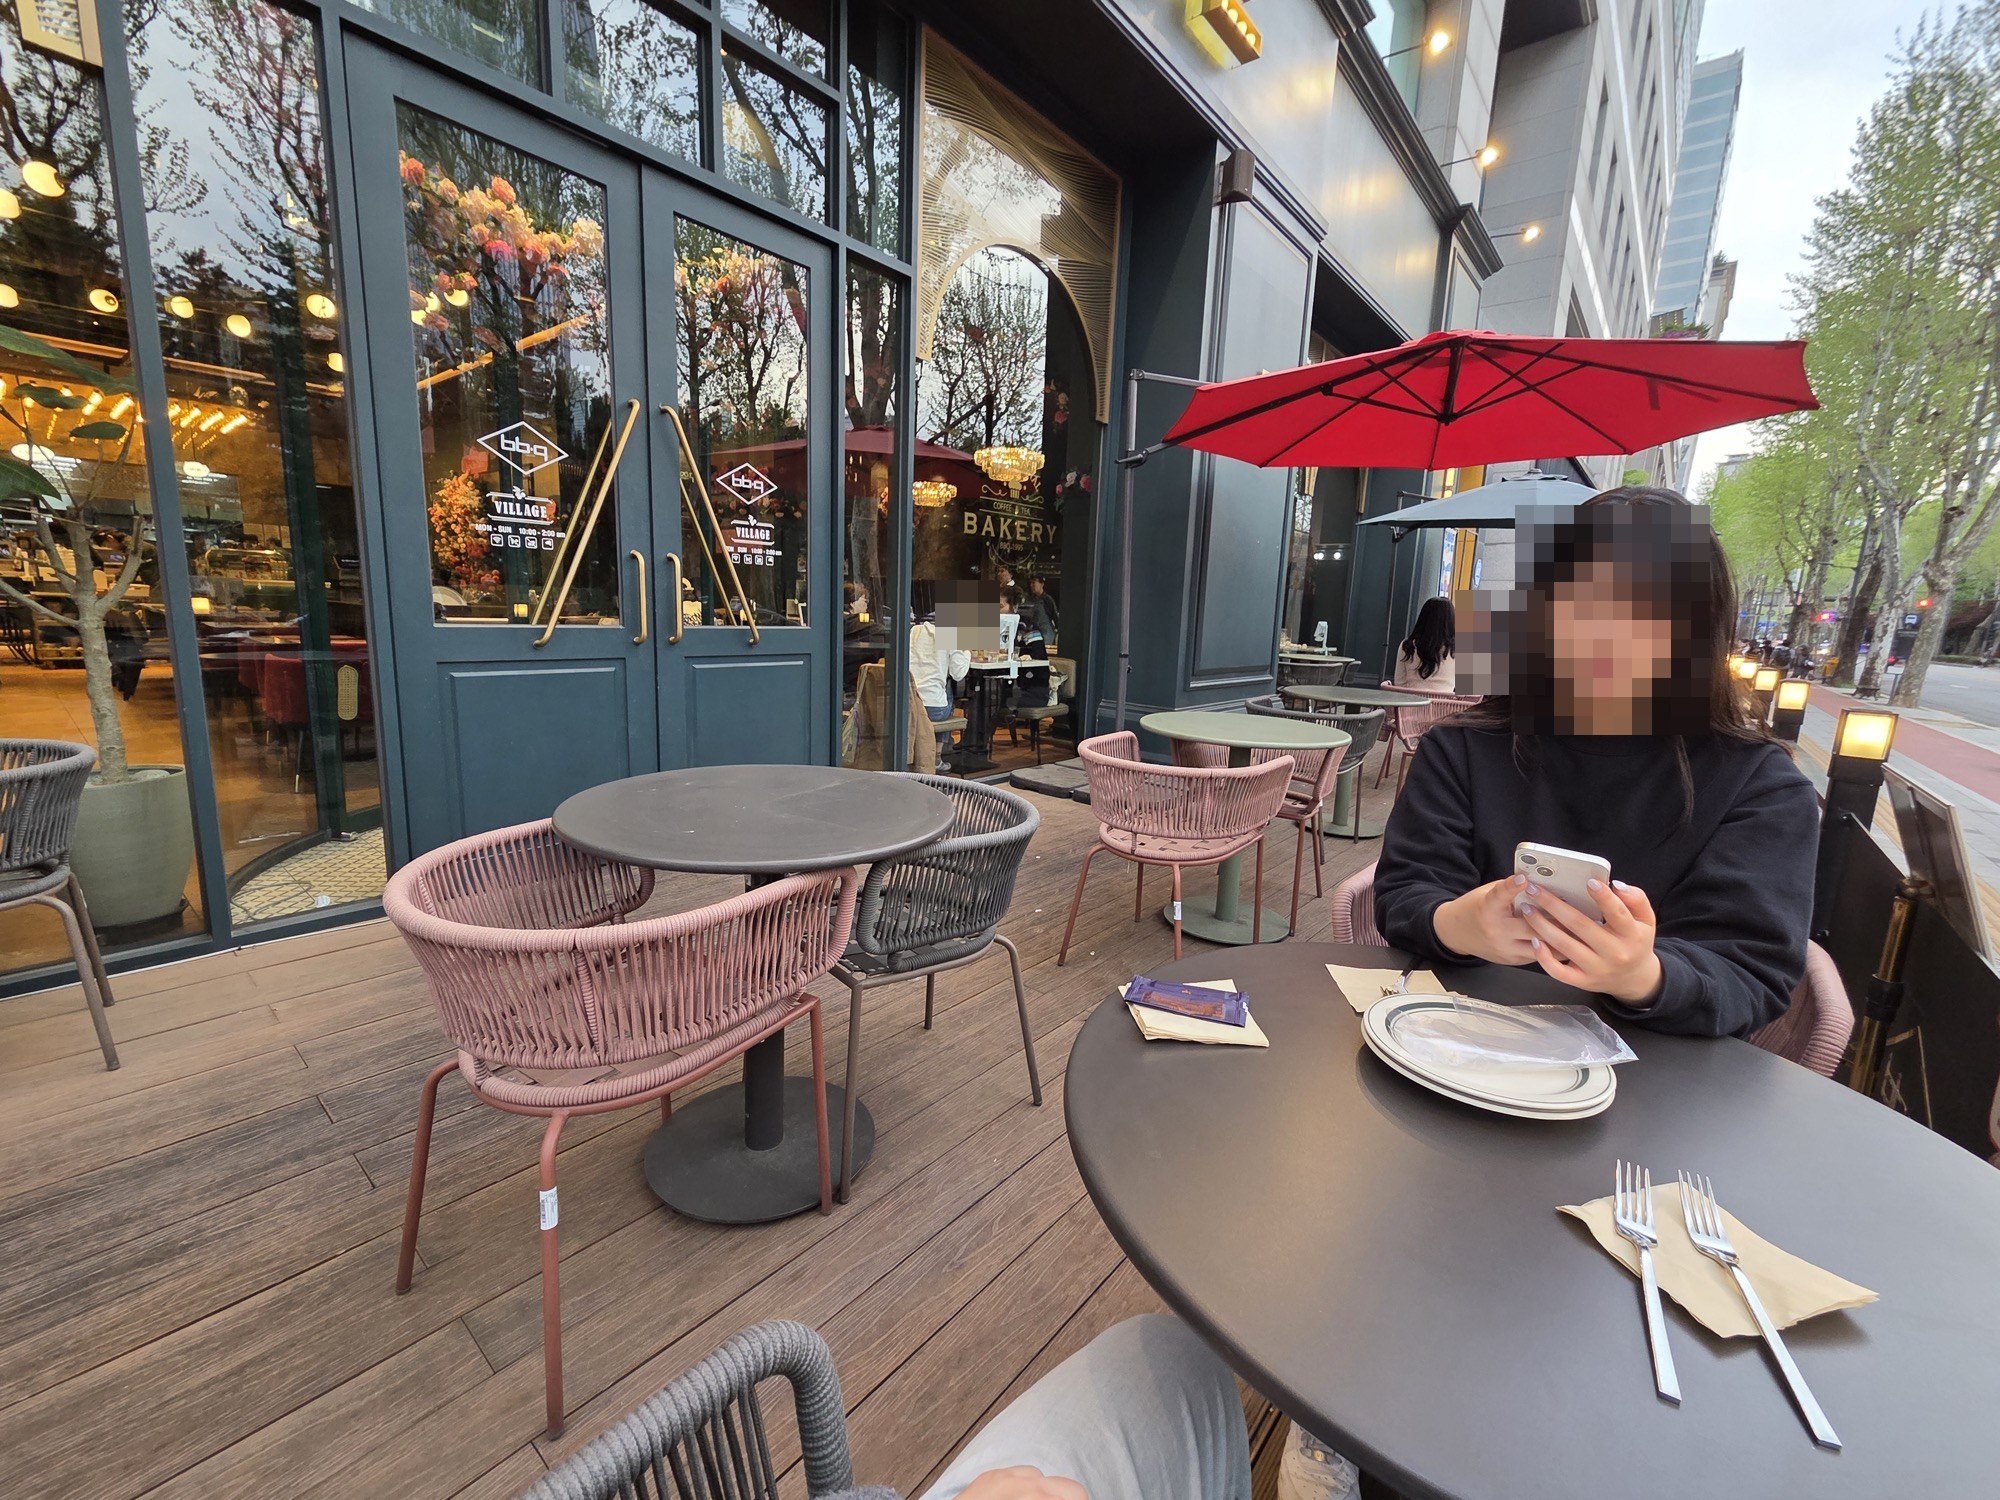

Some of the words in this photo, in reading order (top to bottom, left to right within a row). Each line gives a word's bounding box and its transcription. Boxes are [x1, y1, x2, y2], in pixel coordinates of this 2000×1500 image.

[494, 501, 547, 518] VILLAGE
[993, 501, 1012, 512] COFFEE
[1021, 507, 1031, 516] TEA
[475, 523, 493, 532] MON
[498, 525, 512, 533] SUN
[519, 528, 537, 536] 10:00
[541, 530, 555, 538] 2:00
[736, 527, 770, 540] VILLAGE
[963, 511, 1057, 544] BAKERY
